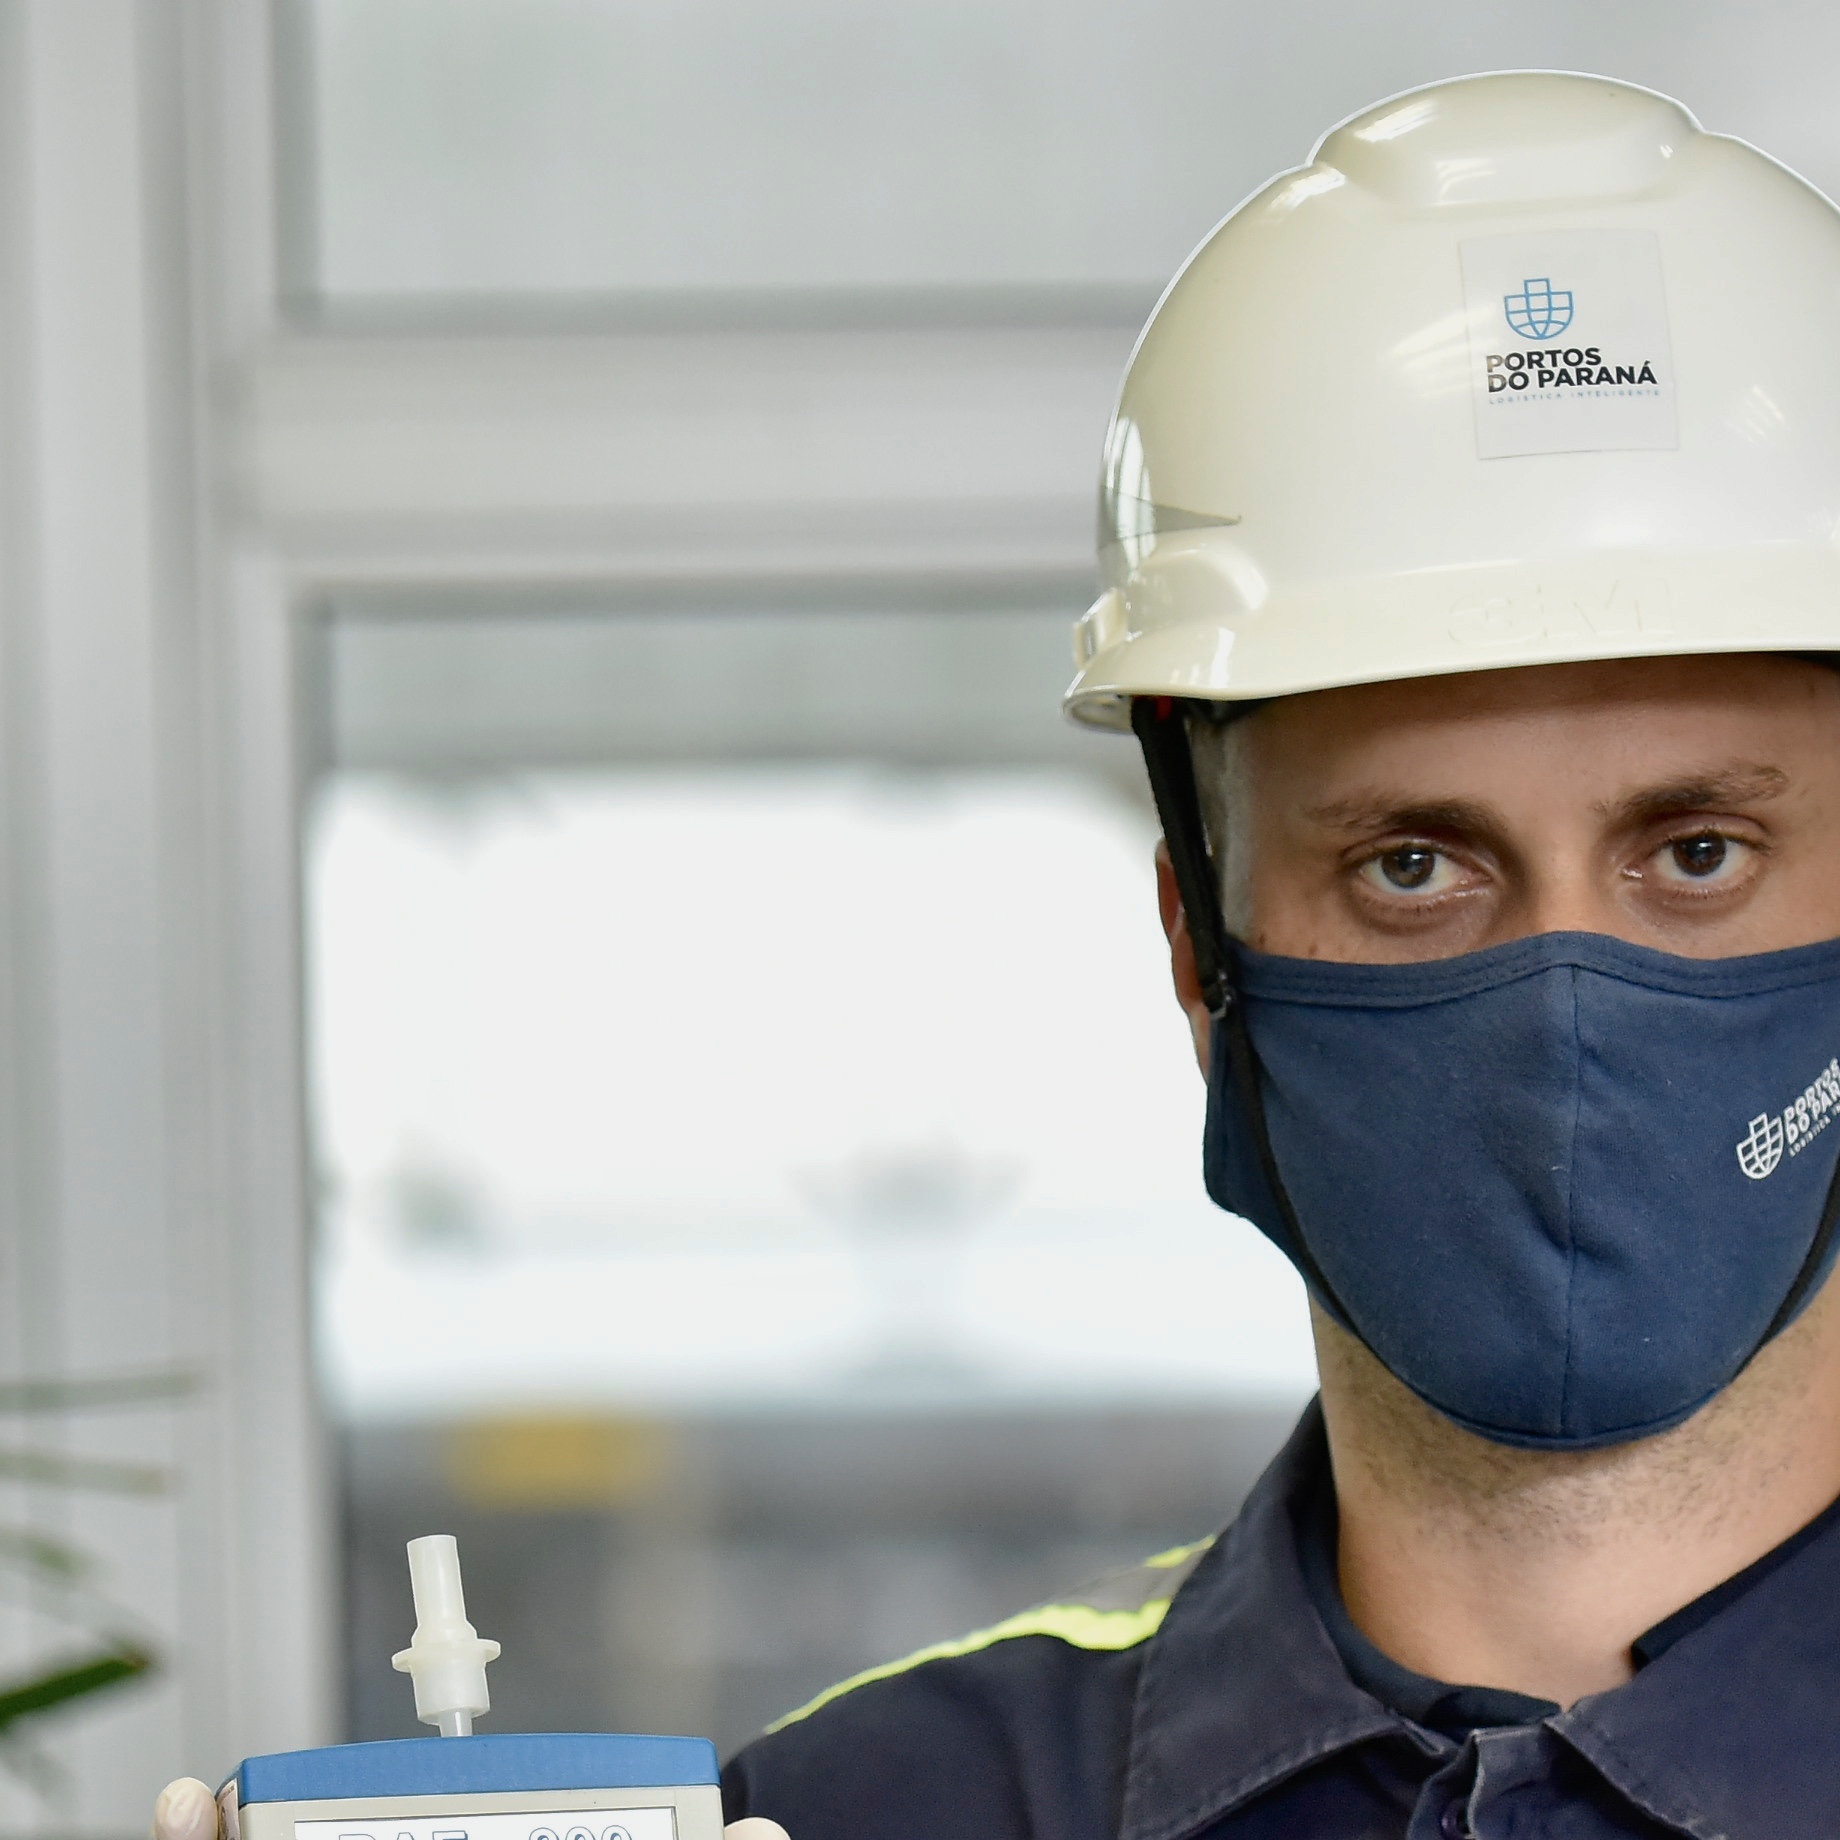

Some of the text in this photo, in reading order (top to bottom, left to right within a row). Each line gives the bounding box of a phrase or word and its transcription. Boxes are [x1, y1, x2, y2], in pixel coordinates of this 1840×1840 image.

[1486, 347, 1602, 373] PORTOS
[1487, 360, 1659, 393] DO PARANÁ
[1784, 1057, 1840, 1121] PORTOS
[1786, 1111, 1811, 1145] DO
